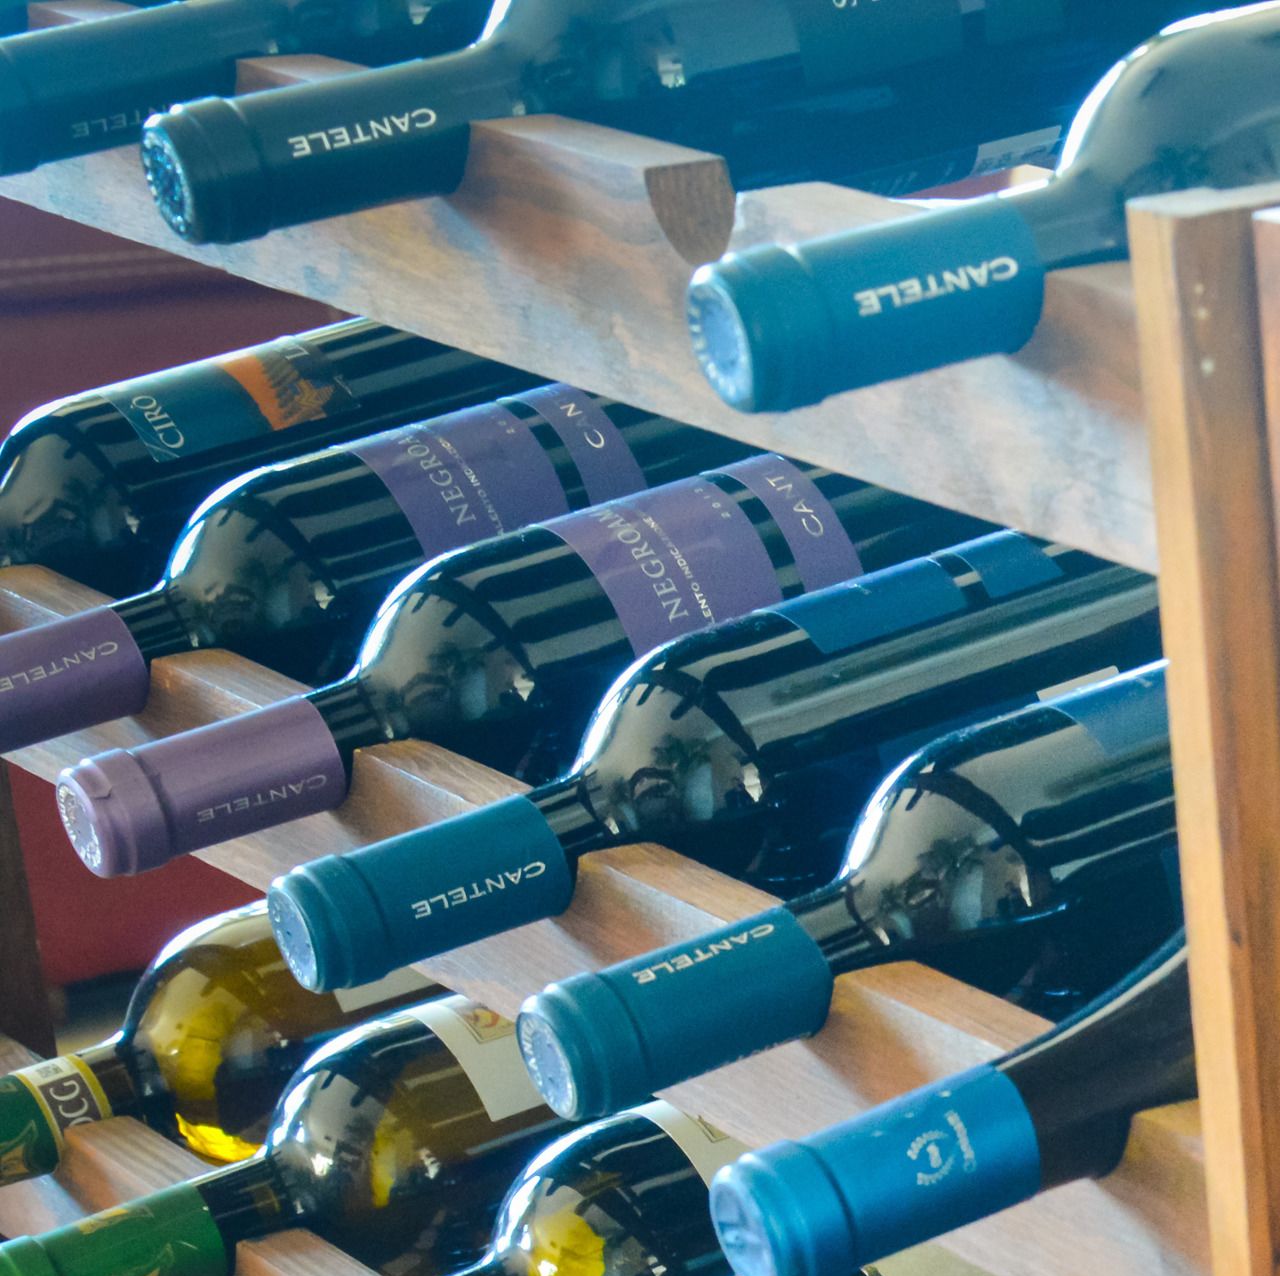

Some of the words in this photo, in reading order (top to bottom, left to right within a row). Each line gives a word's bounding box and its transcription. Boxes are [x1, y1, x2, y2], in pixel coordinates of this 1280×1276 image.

[288, 107, 438, 158] CANTELE
[853, 256, 1019, 316] CANTELE
[0, 641, 119, 692] CANTELE
[196, 773, 328, 823] CANTELE
[411, 861, 547, 920] CANTELE
[633, 922, 775, 986] CANTELE
